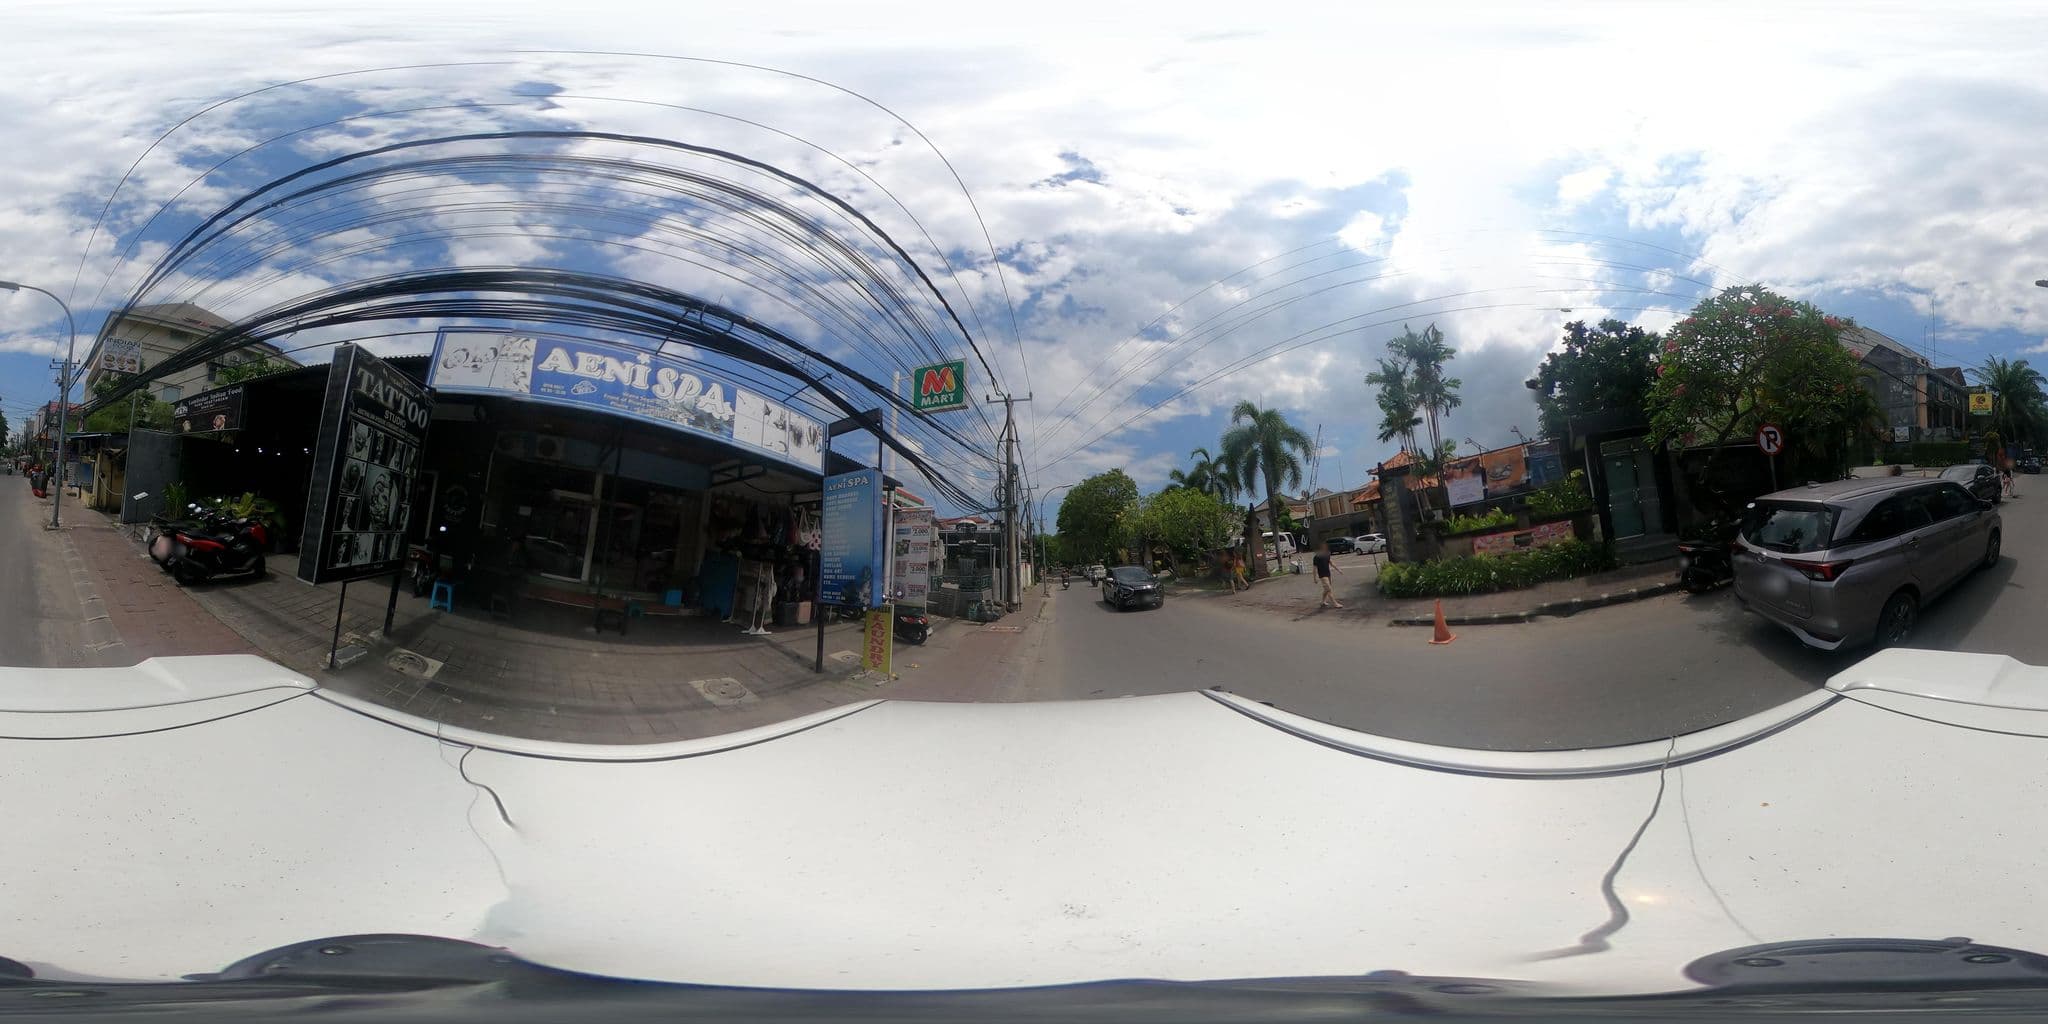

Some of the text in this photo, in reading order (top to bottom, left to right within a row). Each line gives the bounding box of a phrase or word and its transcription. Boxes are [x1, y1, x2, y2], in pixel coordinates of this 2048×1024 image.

[356, 367, 428, 429] TATTOO
[652, 367, 731, 420] SPA
[921, 393, 955, 406] MART
[384, 409, 407, 429] STUDIO
[1766, 430, 1778, 449] P
[847, 476, 868, 487] SPA
